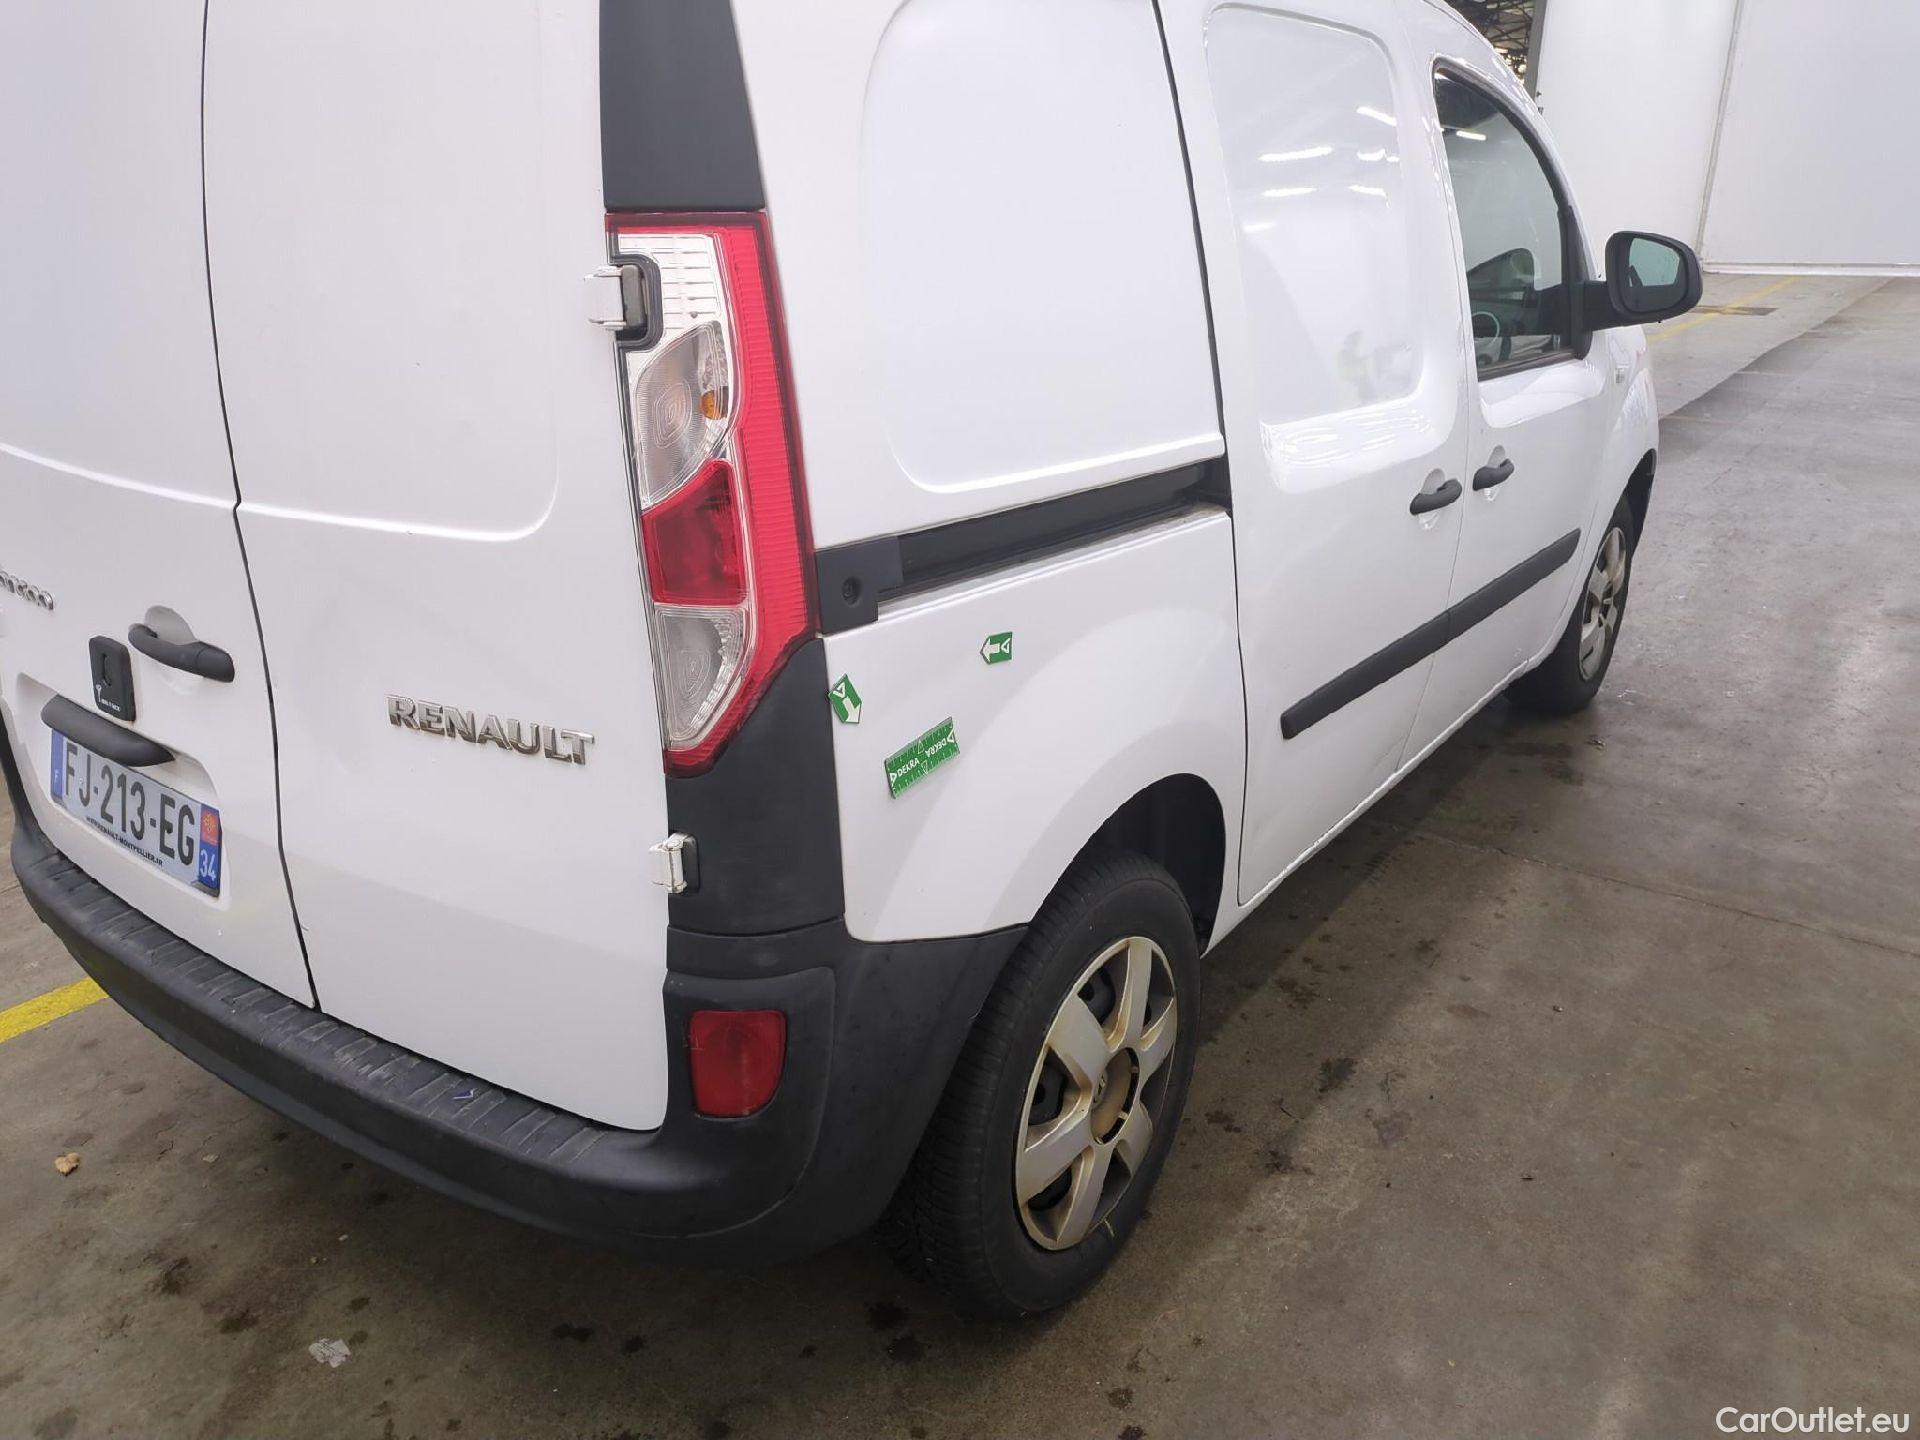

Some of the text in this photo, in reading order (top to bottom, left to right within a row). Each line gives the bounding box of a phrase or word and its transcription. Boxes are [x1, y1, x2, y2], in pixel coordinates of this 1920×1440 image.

[386, 694, 595, 765] RENAULT
[925, 738, 947, 758] DEKRA
[897, 758, 920, 777] DEKRA
[66, 741, 195, 866] FJ-213-EG
[200, 849, 216, 881] 34
